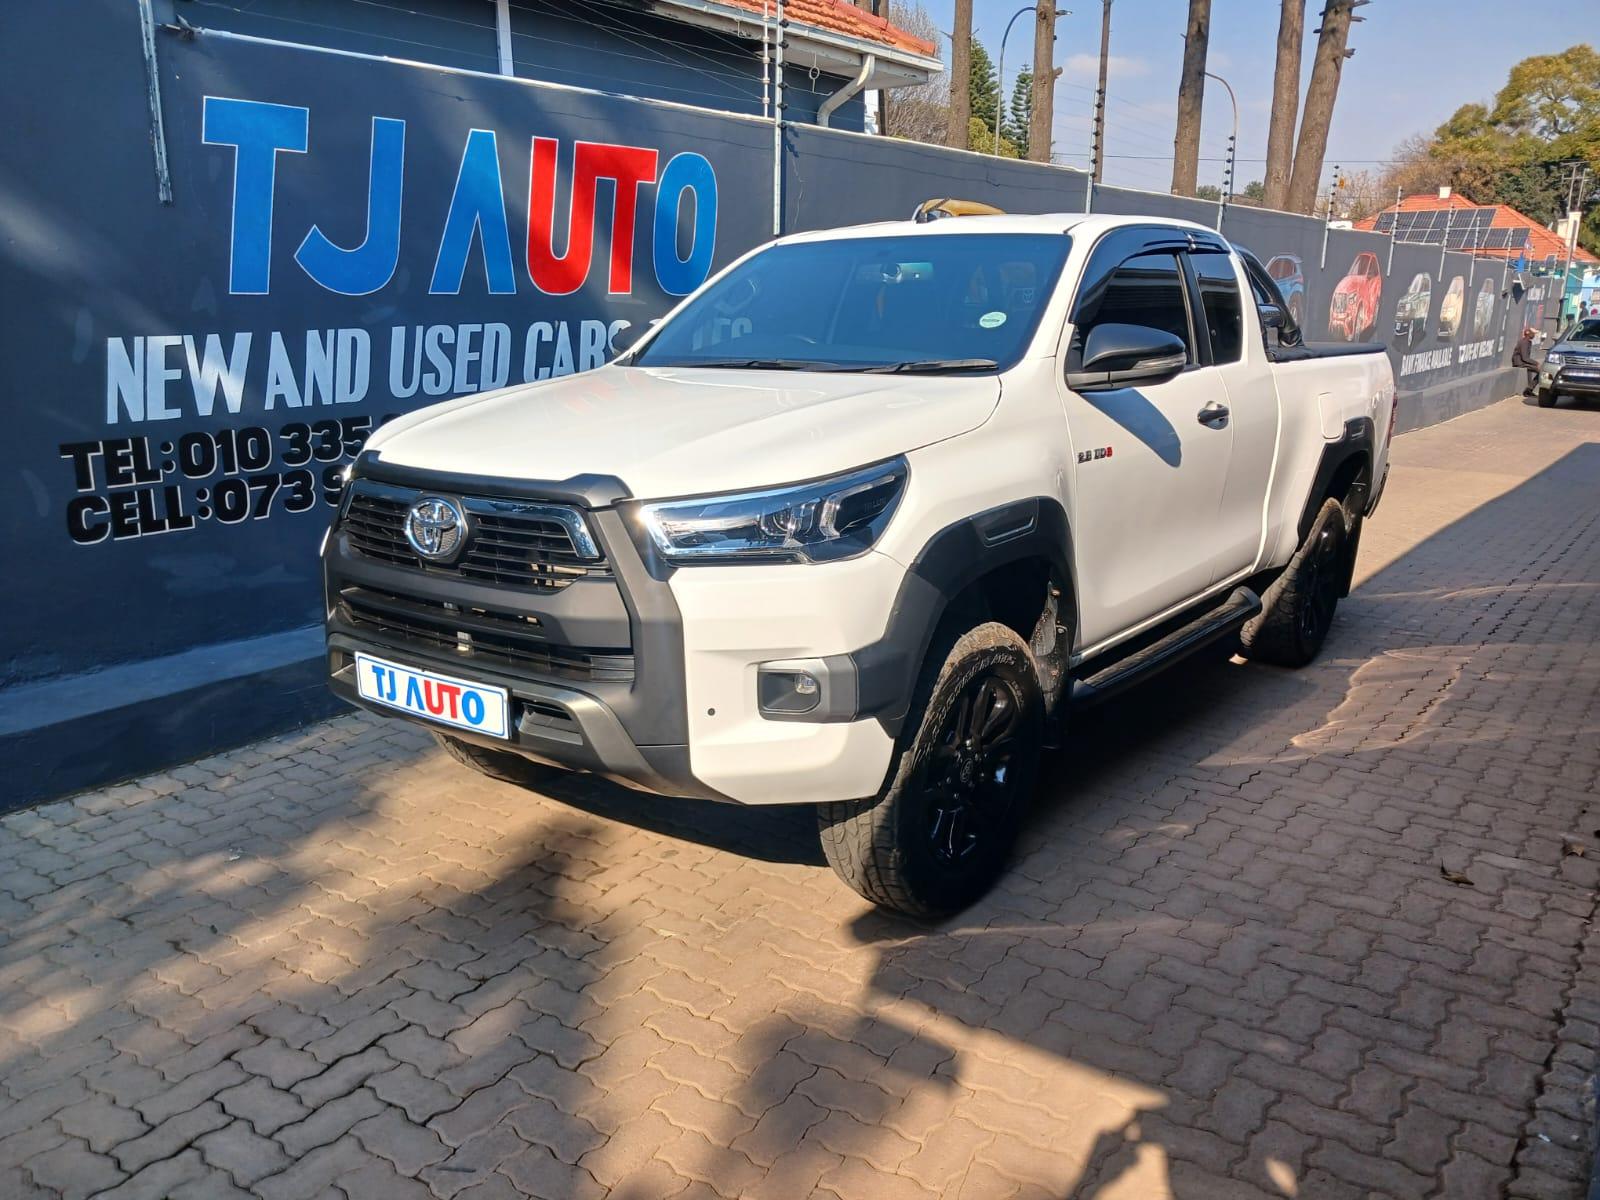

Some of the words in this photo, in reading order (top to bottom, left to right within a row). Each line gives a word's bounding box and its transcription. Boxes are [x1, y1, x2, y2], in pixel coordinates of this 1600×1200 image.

[202, 95, 406, 296] TJ
[428, 128, 718, 296] AUTO
[106, 331, 253, 424] NEW
[264, 328, 372, 411] AND
[388, 322, 512, 399] USED
[59, 426, 273, 492] TEL:010
[280, 414, 373, 467] 335
[66, 469, 316, 546] CELL:073
[371, 664, 397, 702] TJ
[406, 675, 485, 726] AUTO
